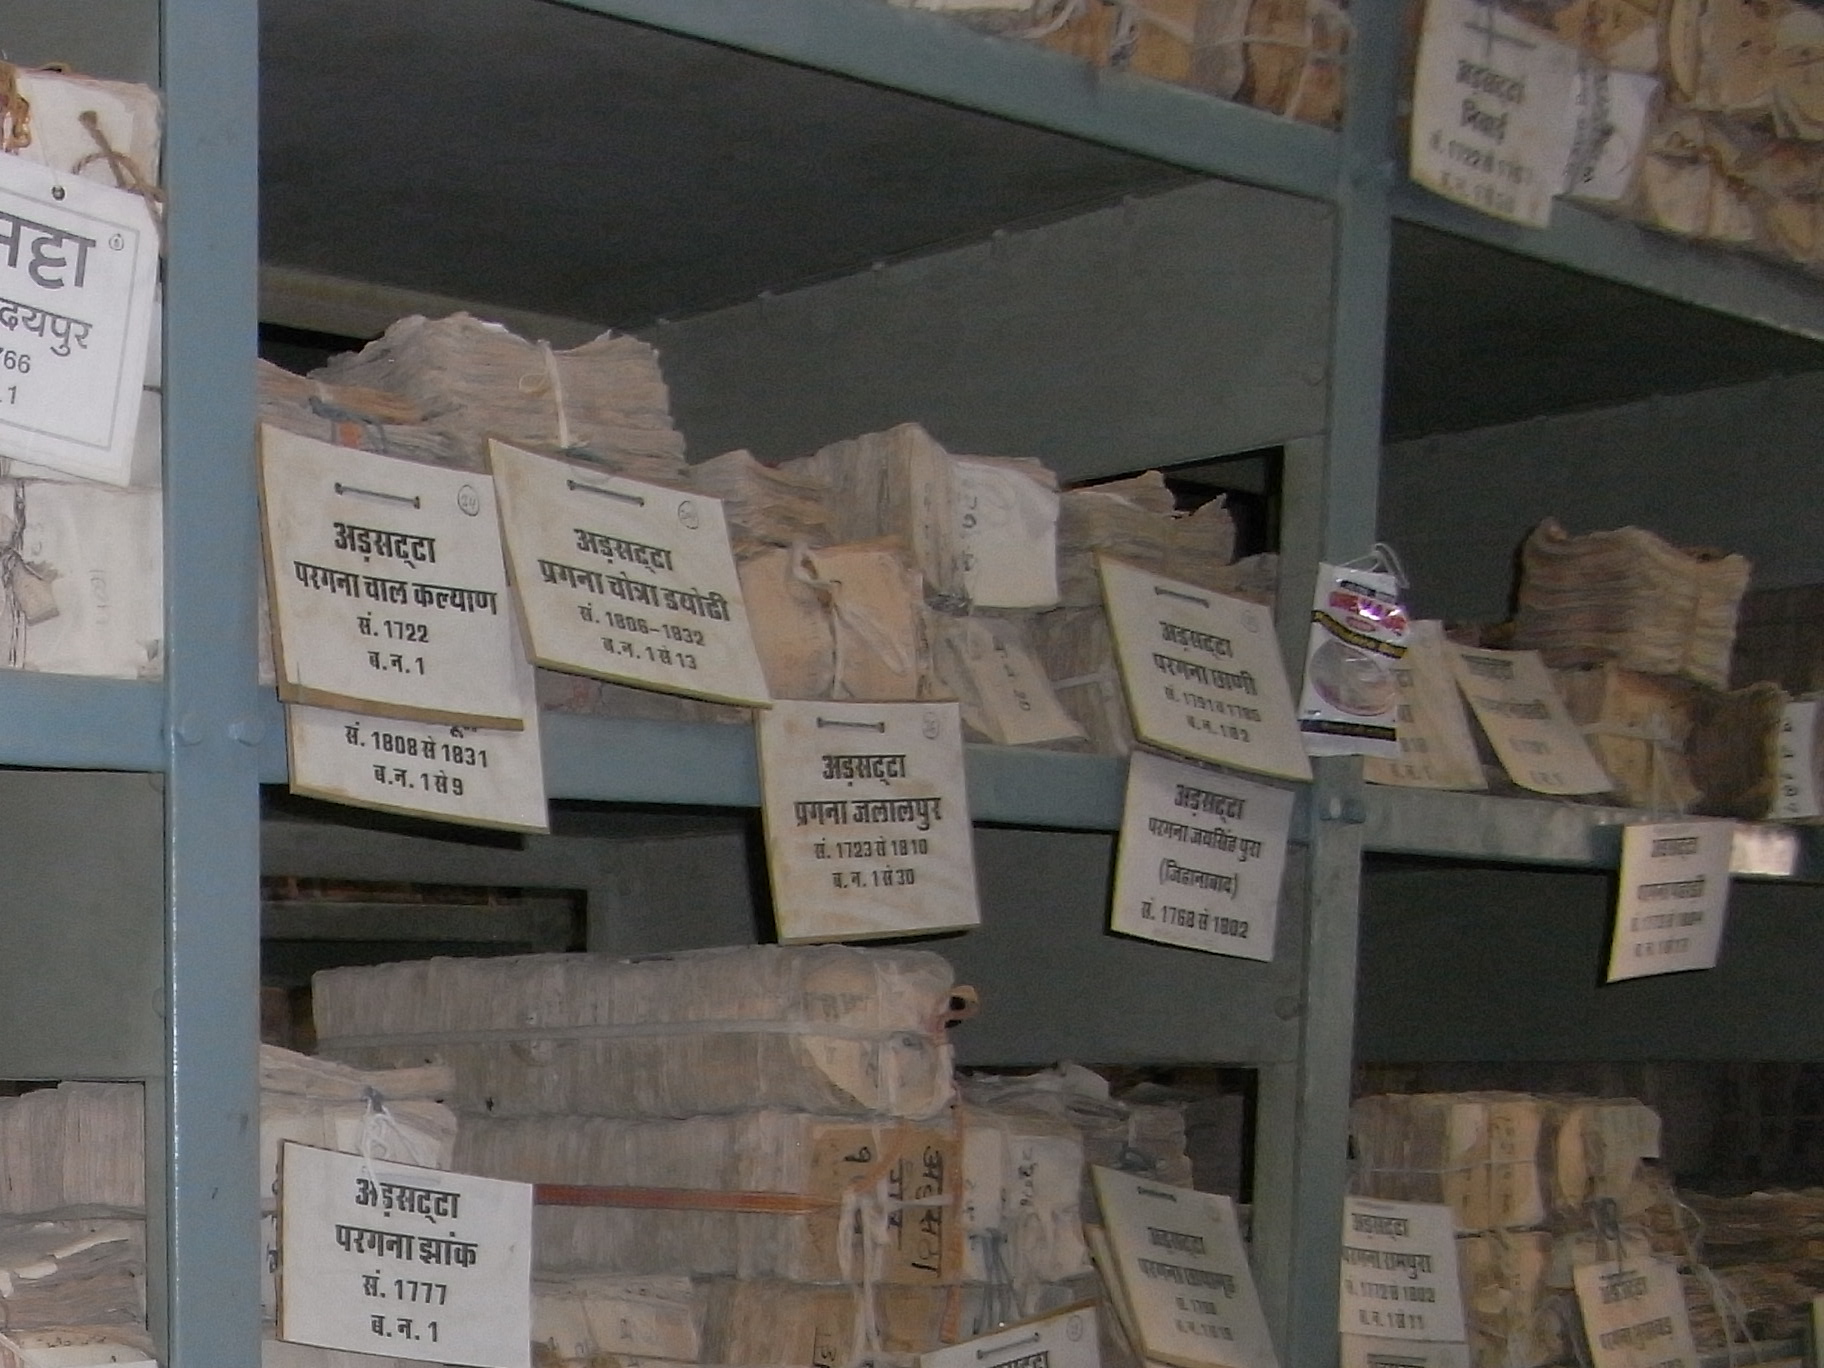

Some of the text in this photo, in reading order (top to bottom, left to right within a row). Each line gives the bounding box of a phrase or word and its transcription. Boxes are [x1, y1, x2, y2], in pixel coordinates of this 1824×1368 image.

[333, 522, 436, 570] अड़सट्टा
[574, 529, 673, 574] अड़सट्टा
[294, 561, 360, 598] परगना
[413, 583, 497, 616] कल्याण
[384, 619, 429, 643] 1722
[1152, 652, 1208, 684] परगना
[822, 754, 906, 786] अड़सट्टा
[851, 798, 941, 831] जलालपुर
[1149, 816, 1189, 844] परगना
[836, 842, 871, 858] 1723
[875, 836, 886, 857] से
[892, 839, 927, 855] 1810
[355, 1178, 461, 1223] अड़सट्टा
[335, 1224, 478, 1268] परगना झांक
[362, 1269, 447, 1305] सं. 1777
[428, 1321, 438, 1342] 1
